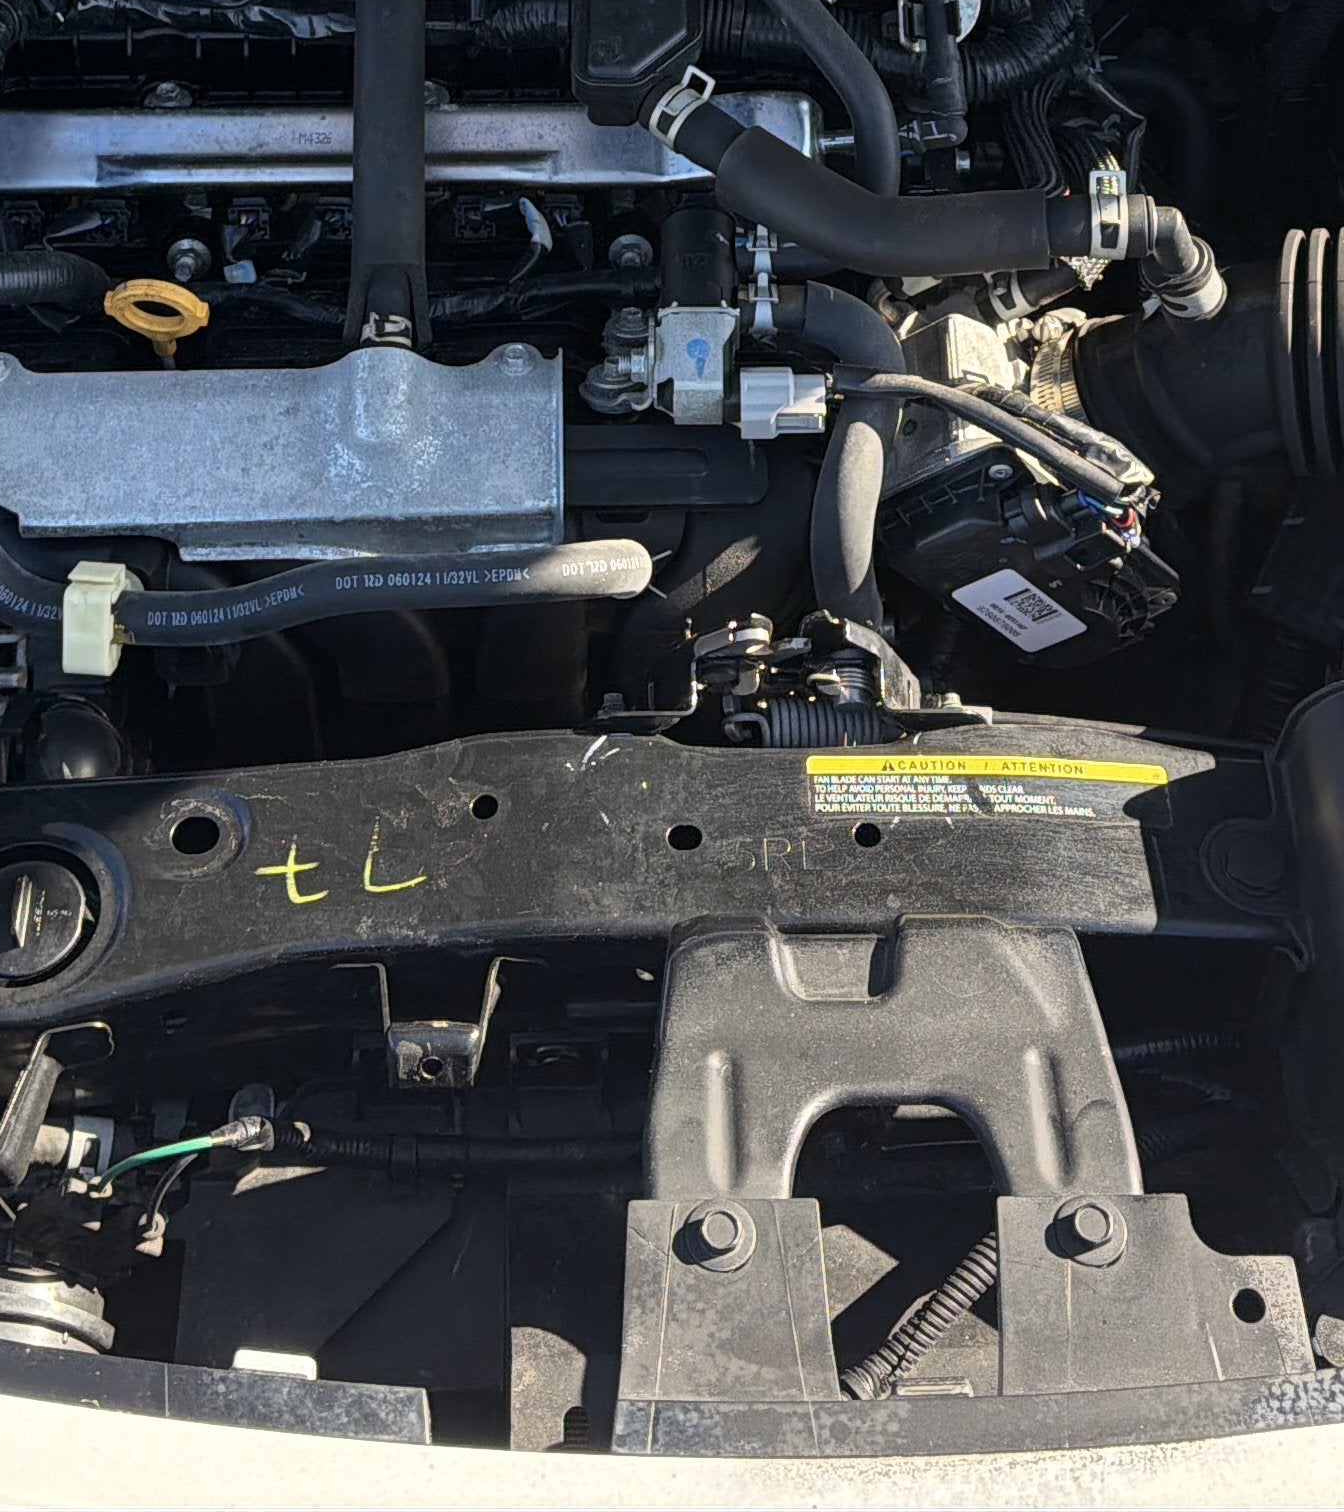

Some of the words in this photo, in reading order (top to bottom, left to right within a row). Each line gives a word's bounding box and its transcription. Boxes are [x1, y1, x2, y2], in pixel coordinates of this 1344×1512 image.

[561, 561, 585, 577] DOT
[335, 575, 359, 591] DOT
[387, 572, 432, 587] 060124
[147, 611, 168, 626] DOT
[190, 607, 225, 626] 060124
[897, 759, 967, 771] CAUTION
[1001, 761, 1085, 775] ATTENTION
[813, 776, 830, 784] FAN
[830, 776, 857, 784] BLADE
[858, 776, 875, 784] CAN
[876, 776, 901, 784] START
[901, 776, 912, 784] AT
[913, 776, 931, 784] ANY
[814, 785, 827, 793] TO
[827, 785, 848, 793] HELP
[848, 785, 875, 793] AVOID
[875, 785, 918, 793] PERSONAL
[947, 785, 968, 793] KEEP
[814, 794, 826, 803] LE
[826, 794, 884, 803] VENTILATEUR
[884, 794, 918, 804] RISQUE
[918, 794, 932, 803] DE
[989, 794, 1014, 804] TOUT
[814, 803, 841, 813] POUR
[872, 803, 901, 813] TOUTE
[948, 804, 961, 813] NE
[1049, 805, 1063, 815] LES
